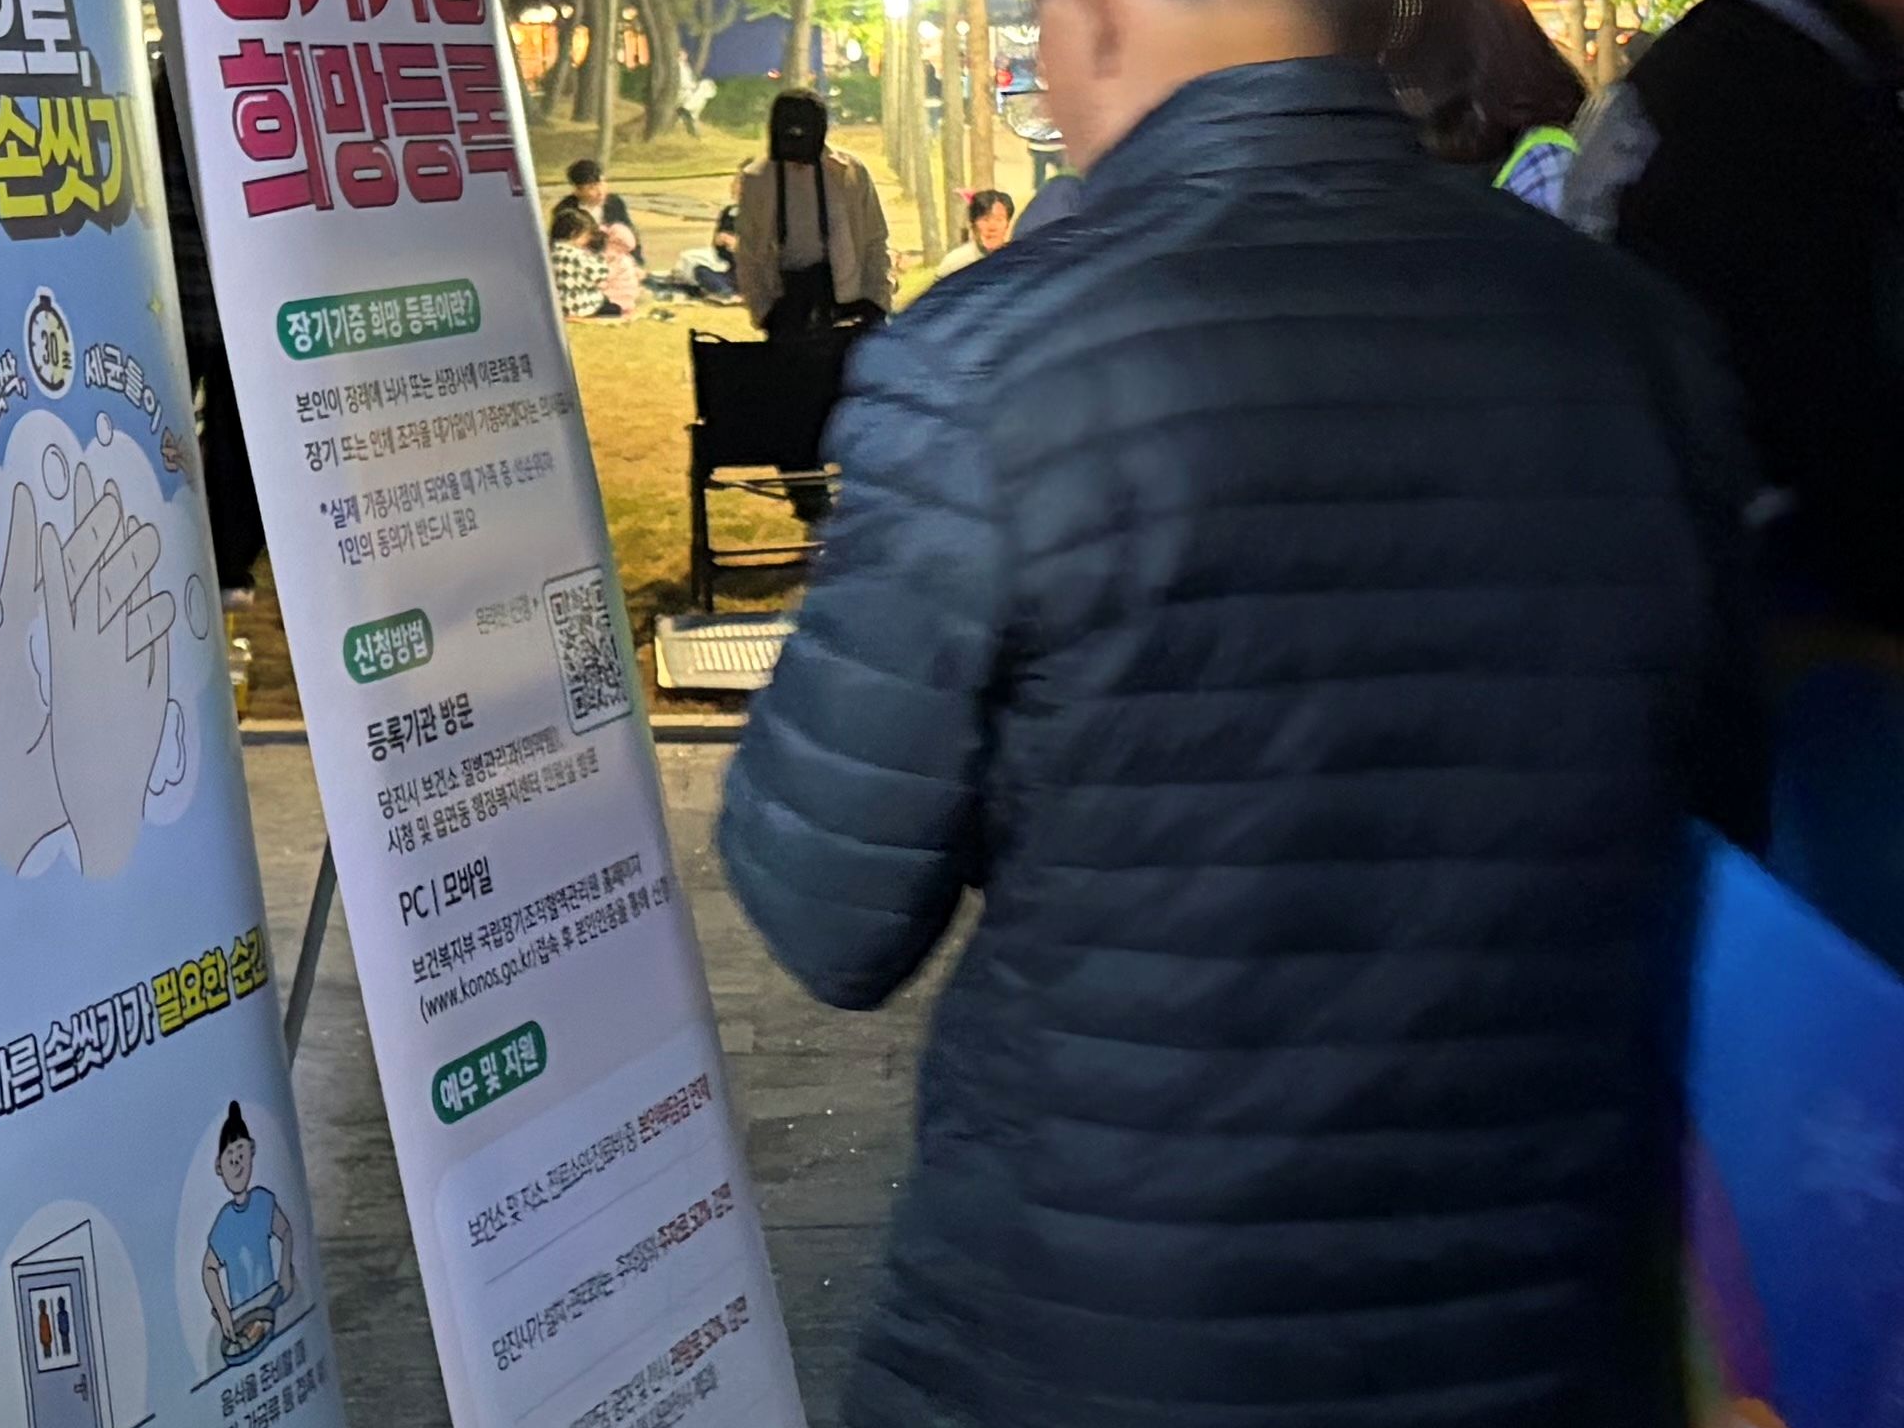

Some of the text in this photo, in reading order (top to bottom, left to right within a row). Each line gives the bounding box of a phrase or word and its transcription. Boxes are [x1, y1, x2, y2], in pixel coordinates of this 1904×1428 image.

[219, 40, 524, 218] 희망등록
[39, 329, 60, 368] 30
[287, 288, 475, 353] 장기기증 희망 등록이란?
[84, 342, 163, 436] 세균들이
[296, 386, 343, 422] 본인이
[345, 380, 384, 414] 장래에
[409, 373, 433, 399] 또는
[304, 438, 339, 473] 장기
[341, 433, 369, 463] 또는
[338, 507, 479, 566] 1인의 동의가 반드시 필요
[353, 618, 429, 676] 신청방법
[367, 692, 474, 762] 등록기관 방문
[377, 778, 421, 820] 당진시
[421, 767, 460, 801] 보건소
[388, 821, 416, 855] 시청
[416, 815, 434, 845] 및
[433, 799, 472, 839] 읍면동
[399, 885, 428, 926] PC
[443, 855, 494, 907] 모바일
[412, 932, 477, 983] 보건복지부
[43, 982, 156, 1094] 손씻기가
[151, 947, 231, 1037] 필요한
[229, 925, 270, 1000] 순간
[440, 1030, 537, 1114] 예우 및 지원
